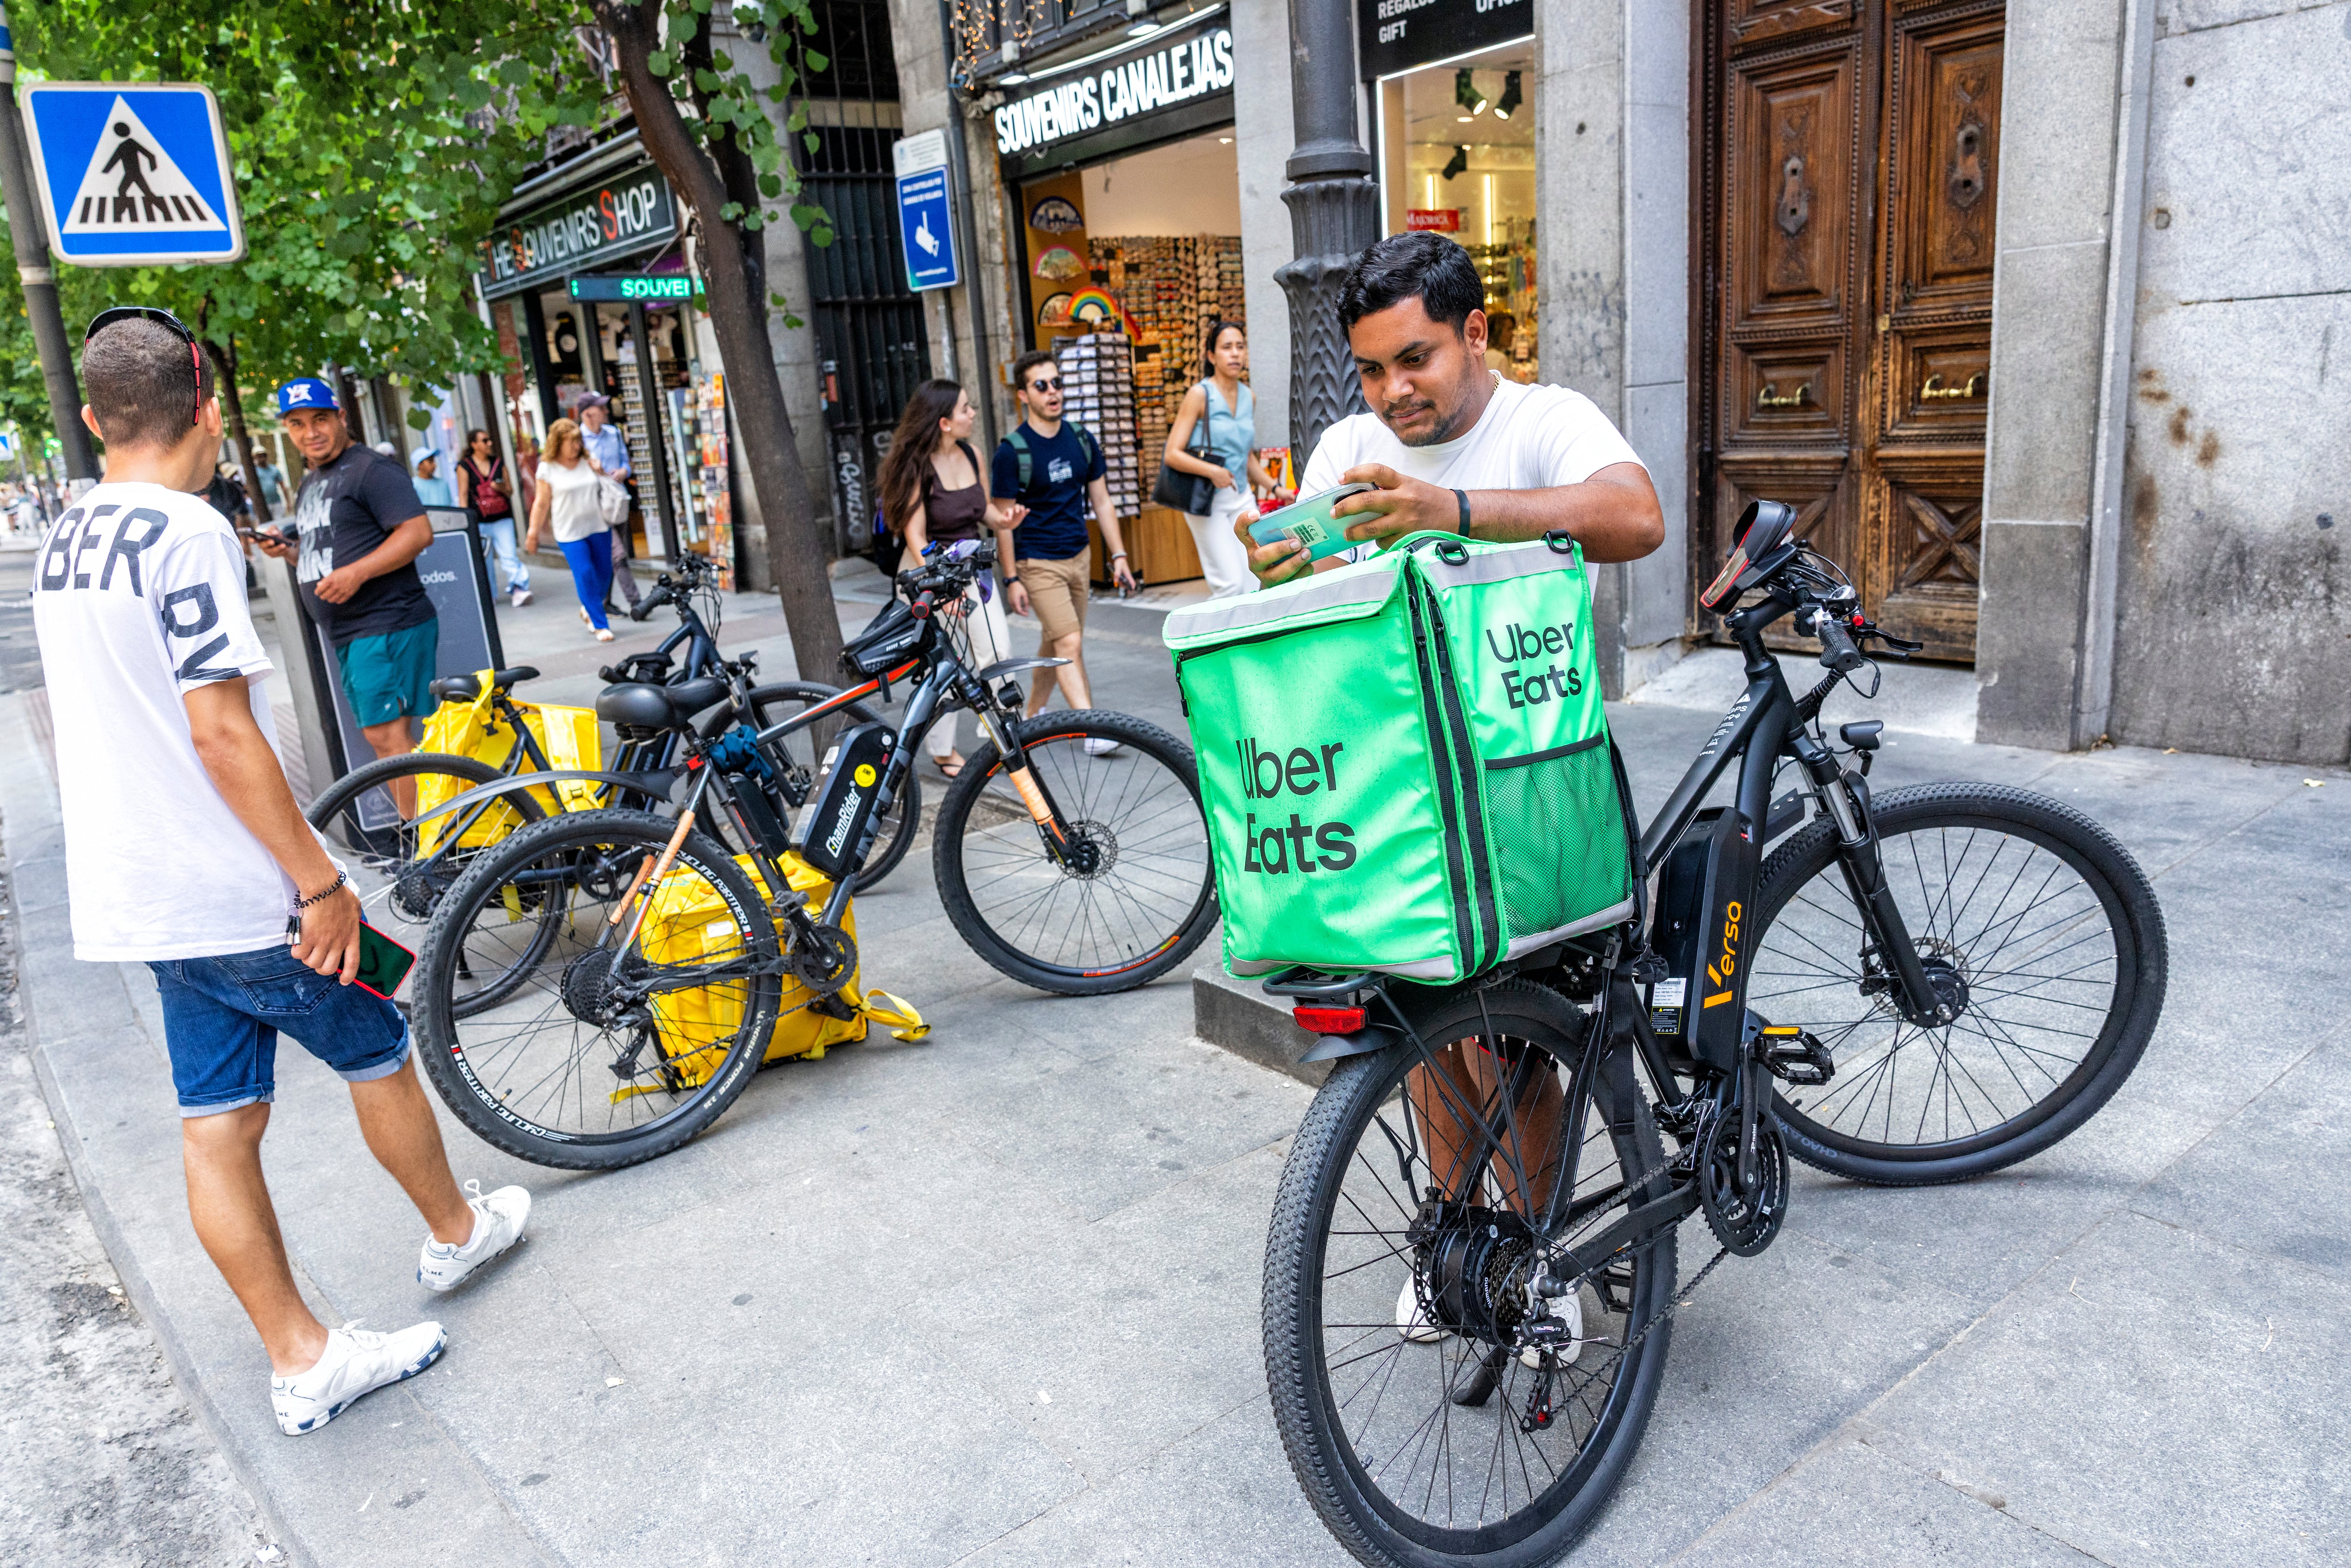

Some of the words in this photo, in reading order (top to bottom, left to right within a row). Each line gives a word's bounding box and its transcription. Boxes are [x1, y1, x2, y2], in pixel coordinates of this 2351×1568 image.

[1379, 19, 1408, 44] GIFT
[994, 76, 1100, 154] SOUVENIRS
[1100, 30, 1234, 122] CANALEJAS
[483, 239, 515, 281] THE
[512, 204, 601, 271] SOUVENIRS
[600, 181, 656, 240] SHOP
[32, 504, 169, 598] BER
[1486, 622, 1574, 664] Uber
[1501, 664, 1582, 710] Eats
[1236, 737, 1343, 799] Uber
[826, 787, 861, 859] ChamRider
[1244, 812, 1357, 875] Eats
[1704, 901, 1742, 1009] Versa
[718, 1061, 744, 1095] FORCE
[1484, 1277, 1493, 1308] SHIMANO
